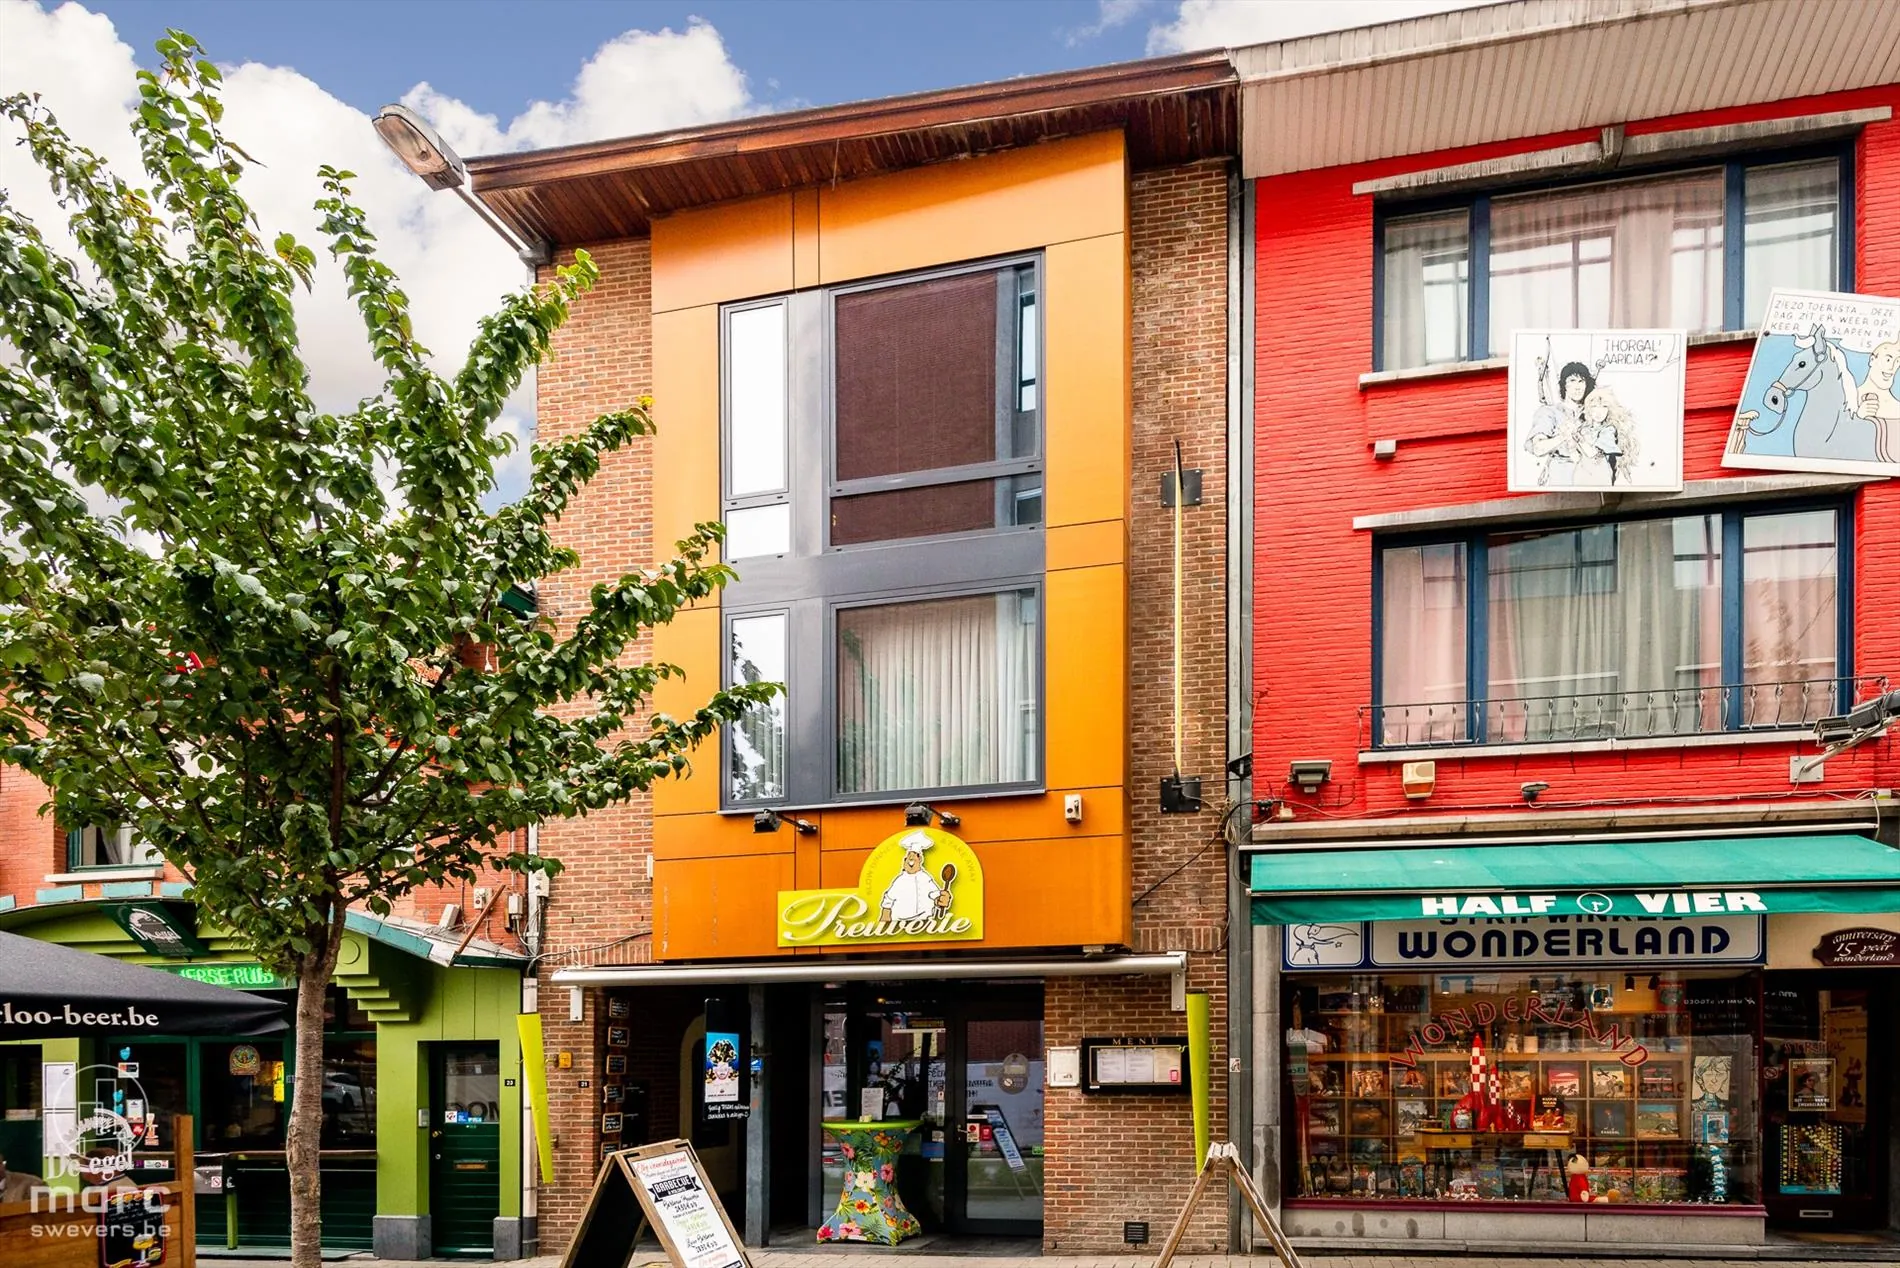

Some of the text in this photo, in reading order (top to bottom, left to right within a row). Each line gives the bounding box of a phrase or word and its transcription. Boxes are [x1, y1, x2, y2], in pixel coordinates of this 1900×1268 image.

[1839, 315, 1869, 325] WEER
[1421, 892, 1767, 916] HALF VIER
[1398, 926, 1731, 959] WONDERLAND
[1832, 931, 1897, 945] anniversary
[1836, 942, 1893, 957] 15 year
[1833, 953, 1895, 963] wonderland
[1389, 996, 1649, 1067] WONDERLAND
[1112, 1037, 1160, 1045] MENU
[46, 1143, 135, 1181] De egel
[654, 1176, 692, 1193] BARBECUE
